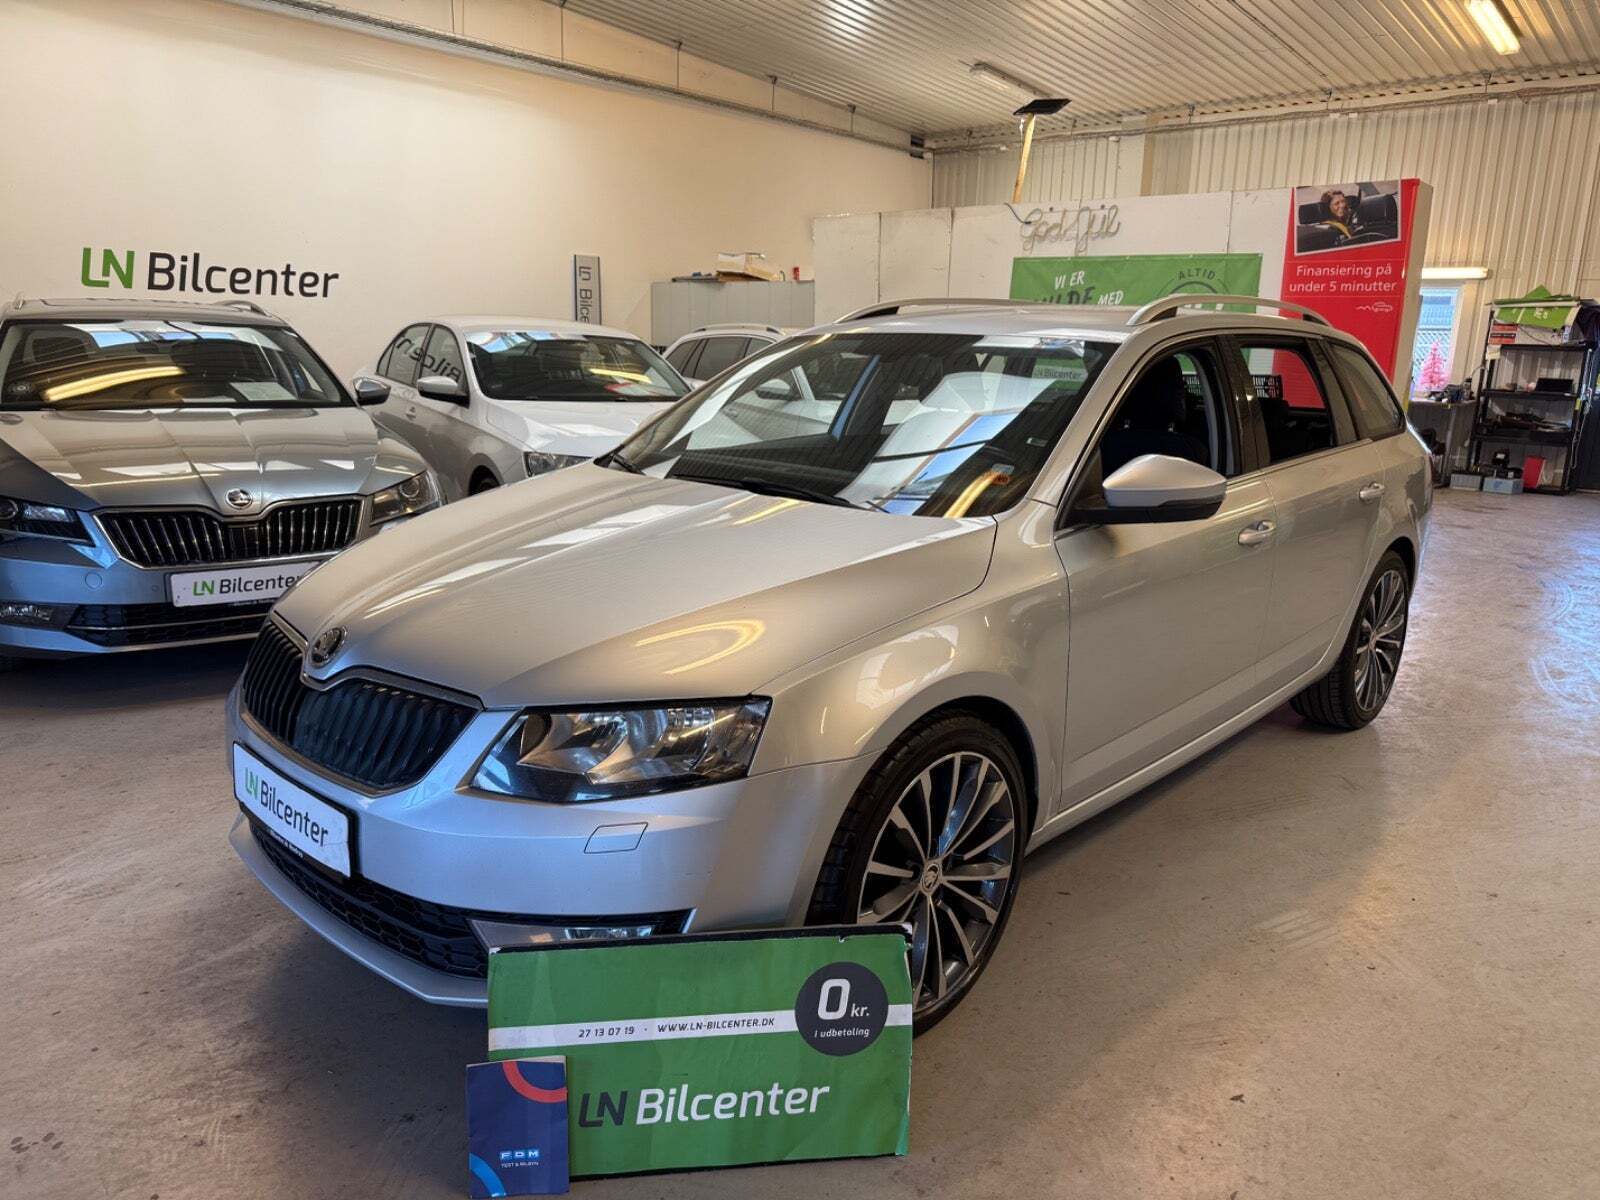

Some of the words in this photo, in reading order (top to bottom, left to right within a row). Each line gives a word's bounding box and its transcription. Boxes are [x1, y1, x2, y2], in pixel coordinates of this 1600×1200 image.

[81, 247, 135, 289] LN
[147, 252, 339, 298] Bilcenter
[1054, 276, 1066, 290] VI
[1070, 270, 1084, 286] ER
[1177, 267, 1216, 282] ALTID
[1296, 264, 1372, 278] Finansiering
[1375, 263, 1393, 279] på
[1289, 281, 1326, 293] under
[1329, 281, 1337, 292] 5
[1340, 280, 1398, 292] minutter
[1098, 290, 1124, 306] MED
[192, 580, 215, 597] LN
[244, 767, 259, 799] LN
[260, 779, 329, 848] Bilcenter
[817, 978, 851, 1020] 0
[850, 1003, 870, 1018] kr.
[578, 1029, 591, 1038] 27
[594, 1028, 605, 1037] 13
[607, 1027, 621, 1036] 07
[624, 1026, 635, 1036] 19
[657, 1017, 776, 1033] WWW.LN-BILCENTER.DK
[820, 1027, 870, 1038] udbetaling
[578, 1090, 628, 1128] LN
[636, 1082, 830, 1126] Bilcenter
